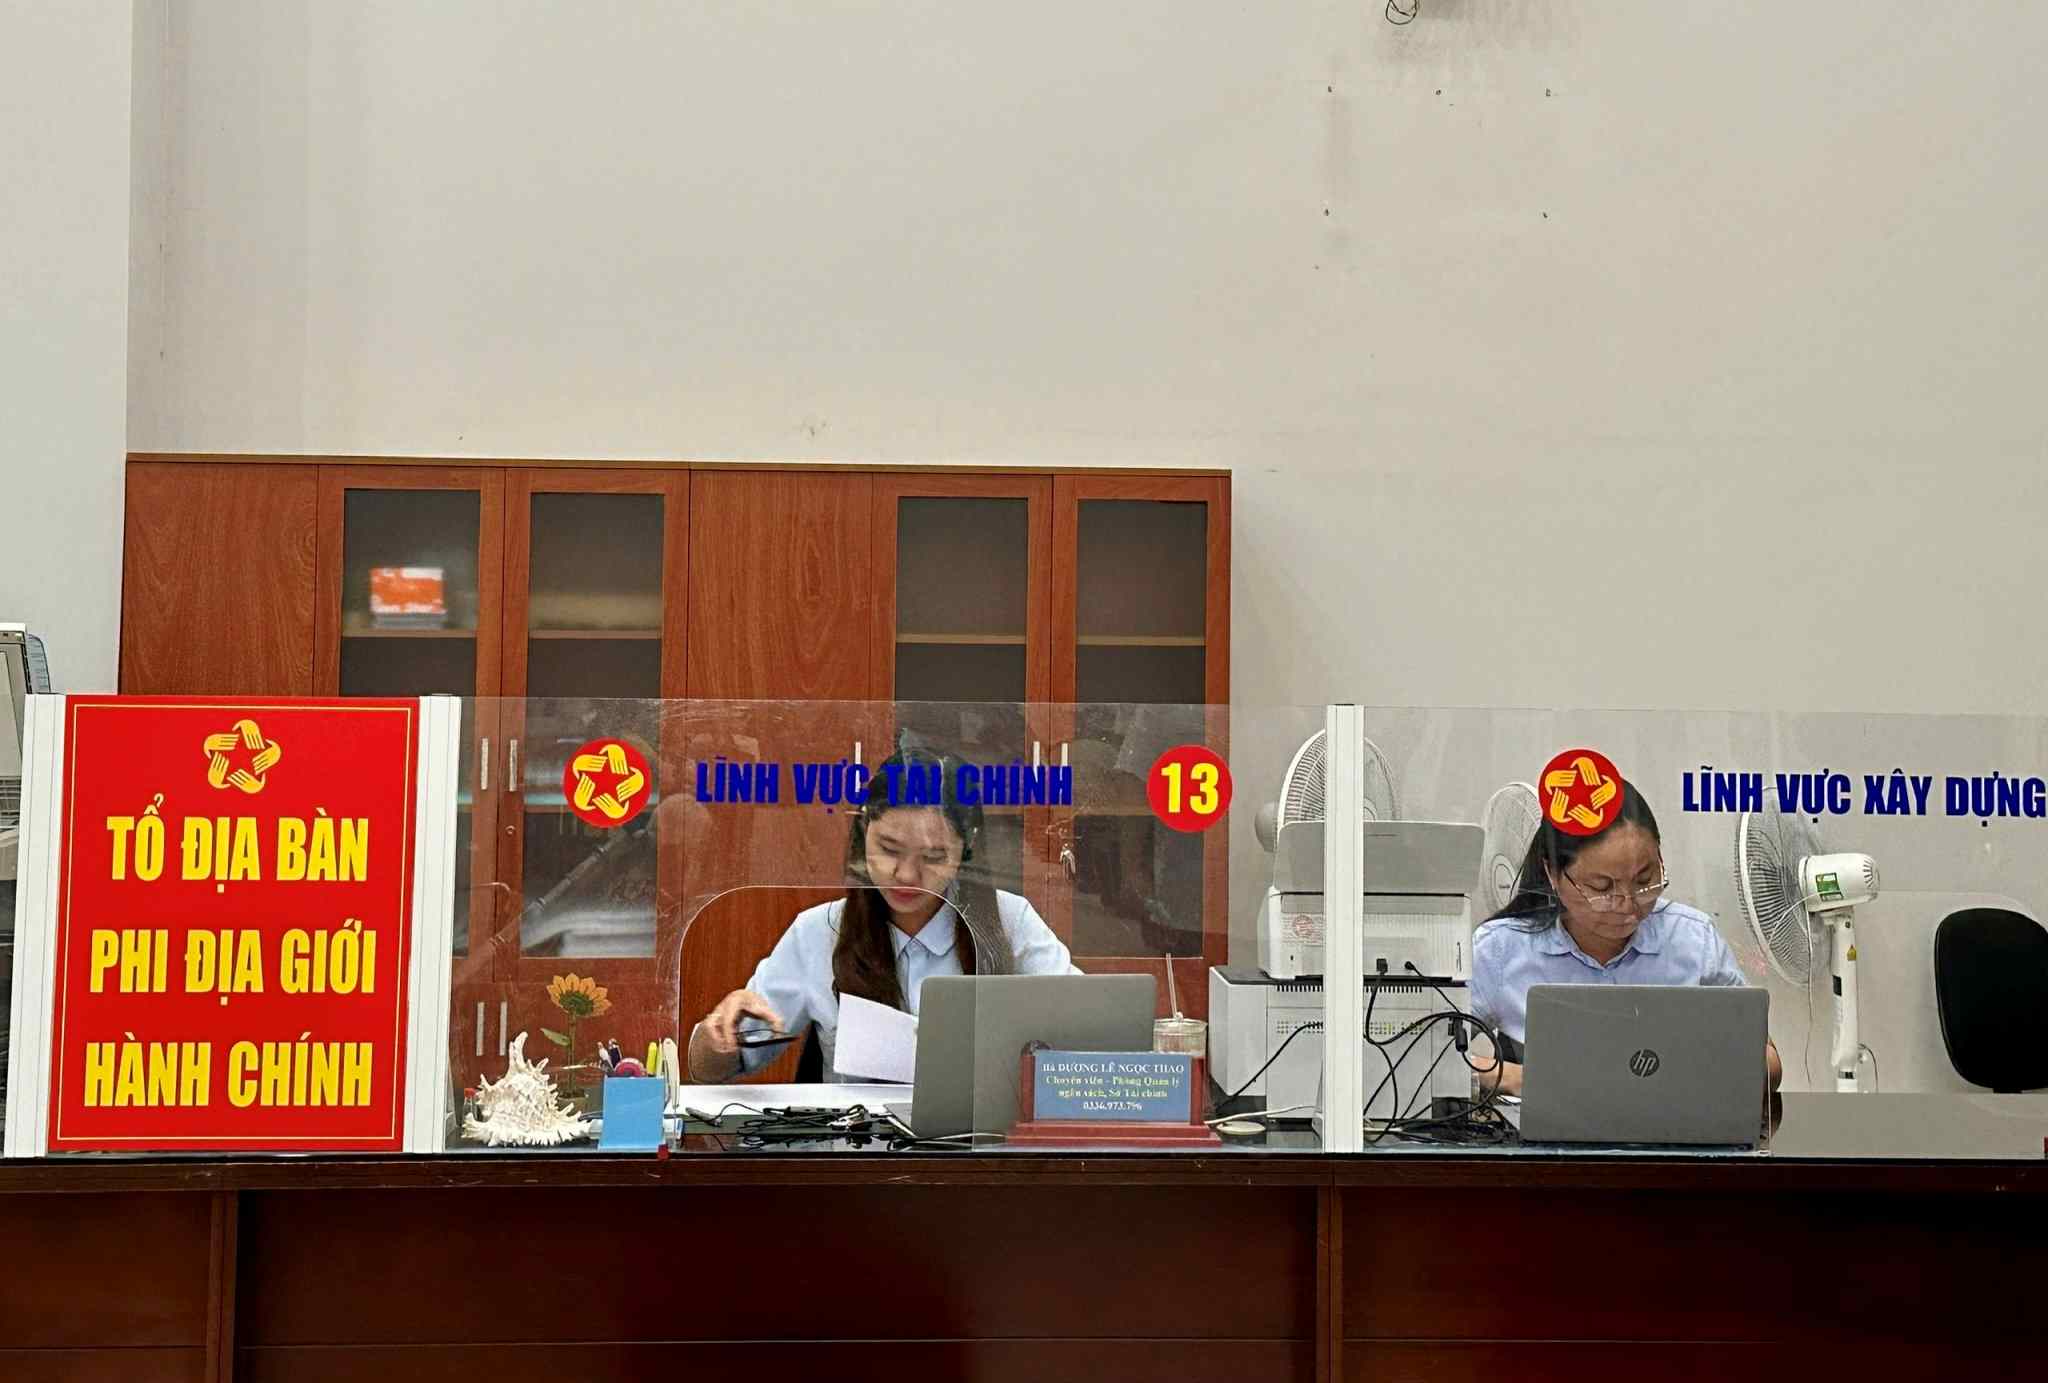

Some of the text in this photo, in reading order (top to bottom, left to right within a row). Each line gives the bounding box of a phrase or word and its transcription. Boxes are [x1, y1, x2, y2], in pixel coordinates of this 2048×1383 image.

[696, 757, 779, 804] LĨNH
[793, 759, 871, 815] VỰC
[955, 757, 1073, 807] CHÍNH
[1161, 762, 1219, 815] 13
[1682, 766, 2047, 827] LĨNH VỰC XÂY DỰNG
[106, 793, 369, 893] TỔ ĐỊA BÀN
[90, 918, 377, 1006] PHI ĐỊA GIỚI
[84, 1031, 373, 1107] HÀNH CHÍNH
[1631, 1049, 1659, 1078] hp
